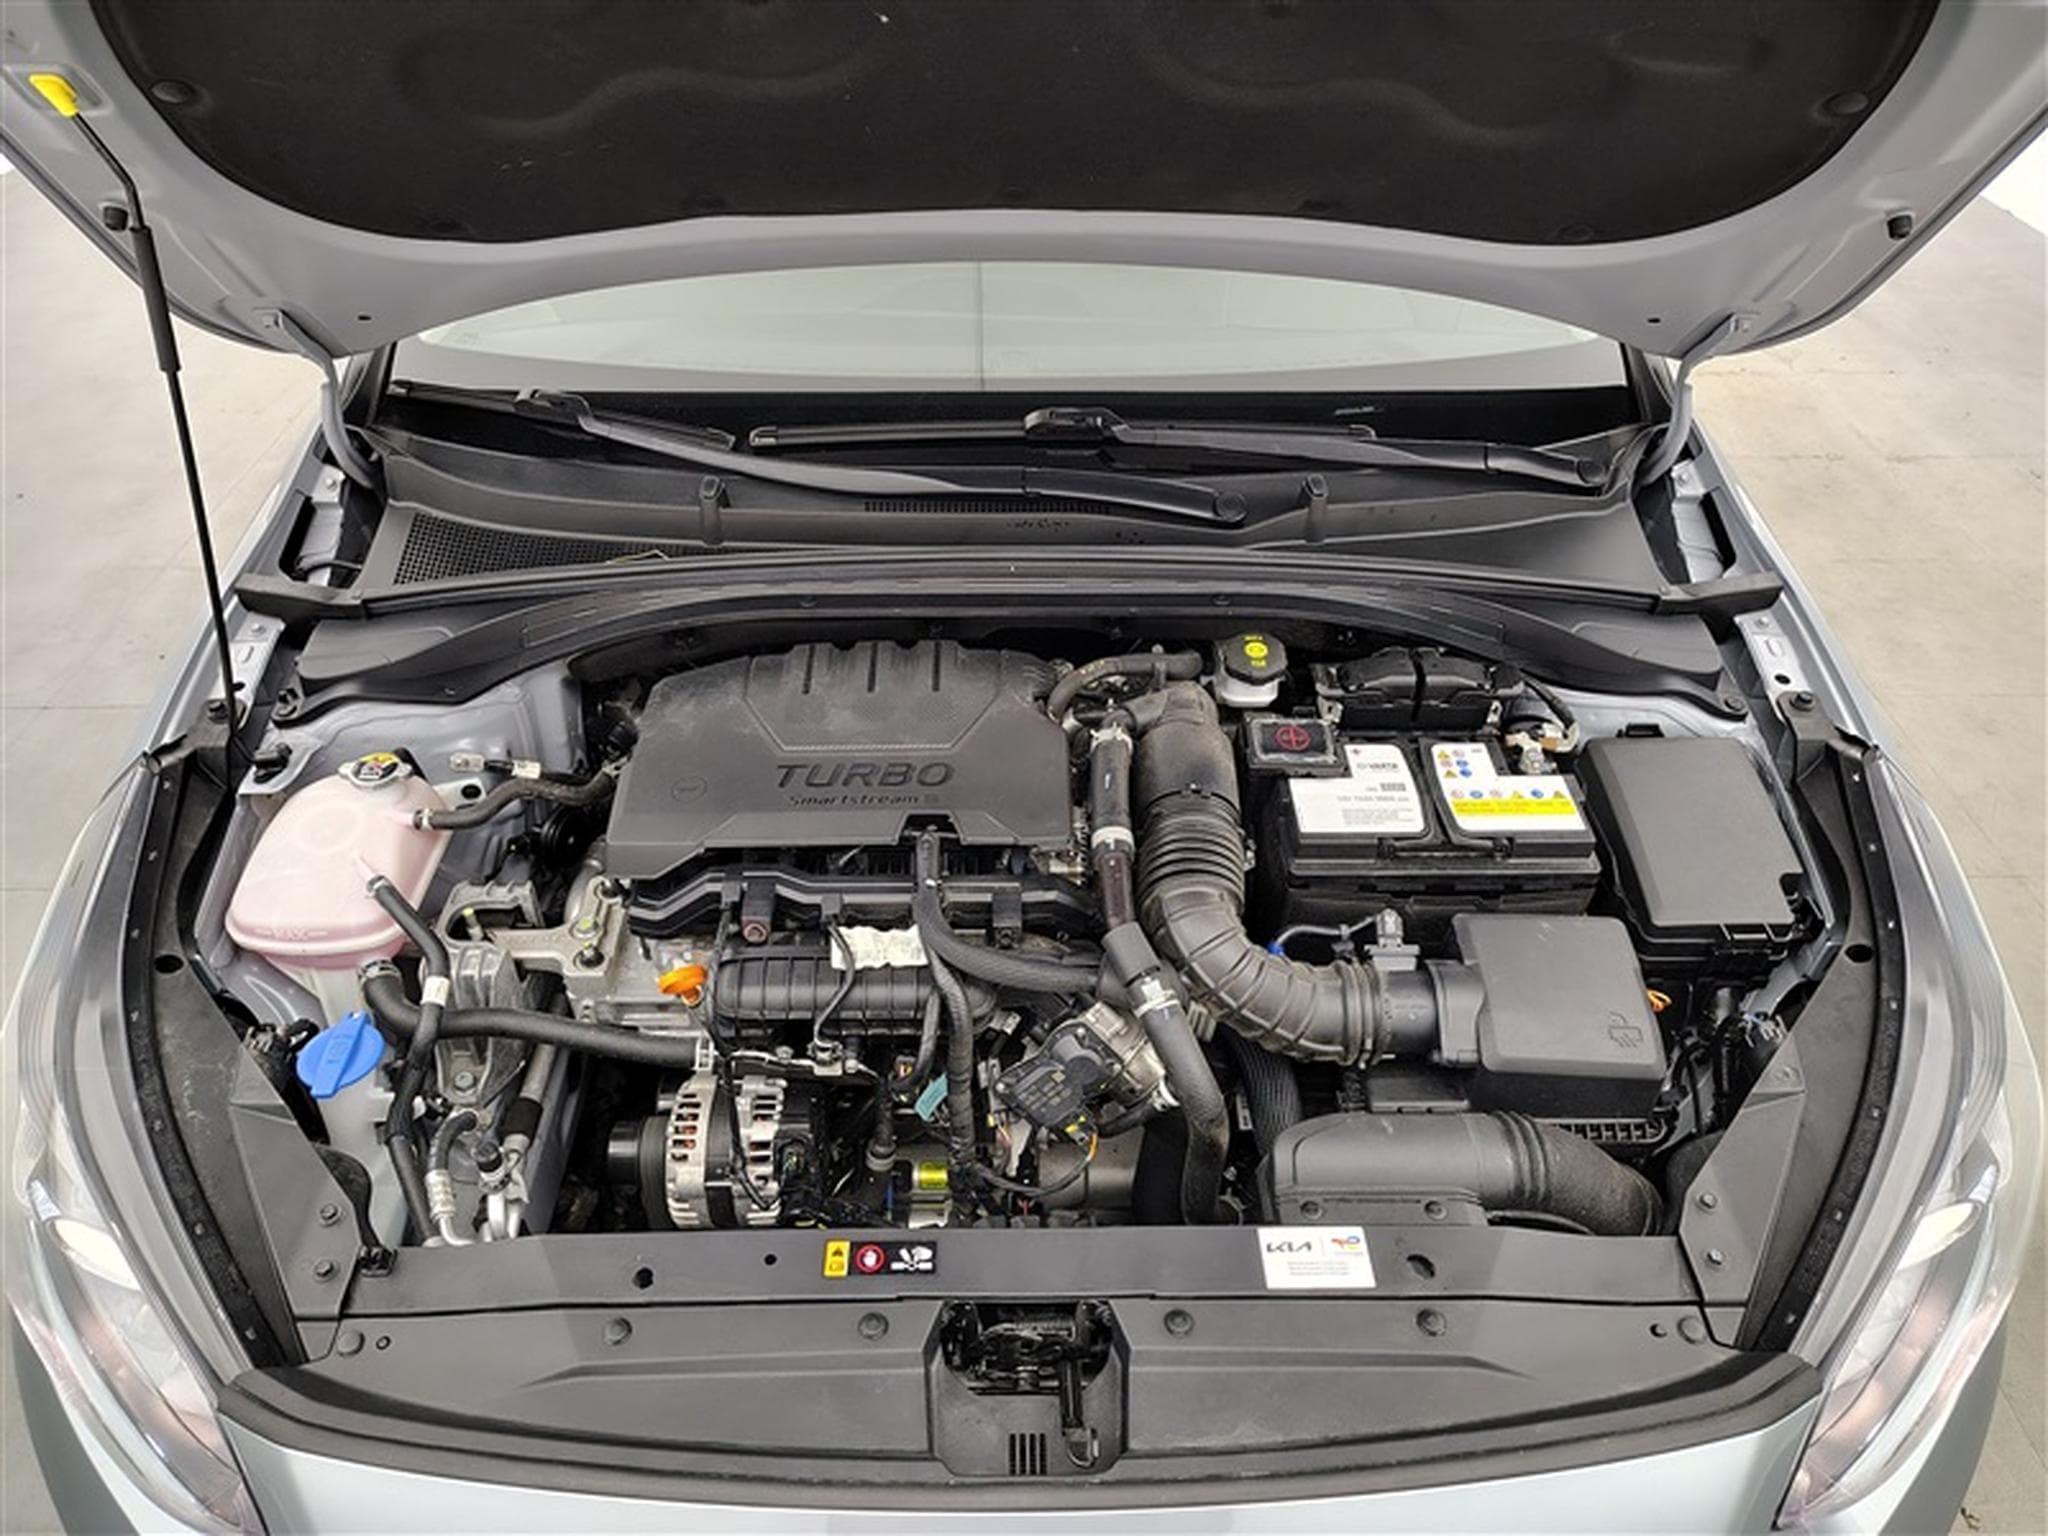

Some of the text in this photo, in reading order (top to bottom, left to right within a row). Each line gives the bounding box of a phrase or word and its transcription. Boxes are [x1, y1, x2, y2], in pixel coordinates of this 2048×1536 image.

[777, 762, 955, 788] TURBO
[789, 794, 919, 806] Smartstream
[1266, 1241, 1312, 1253] KIA
